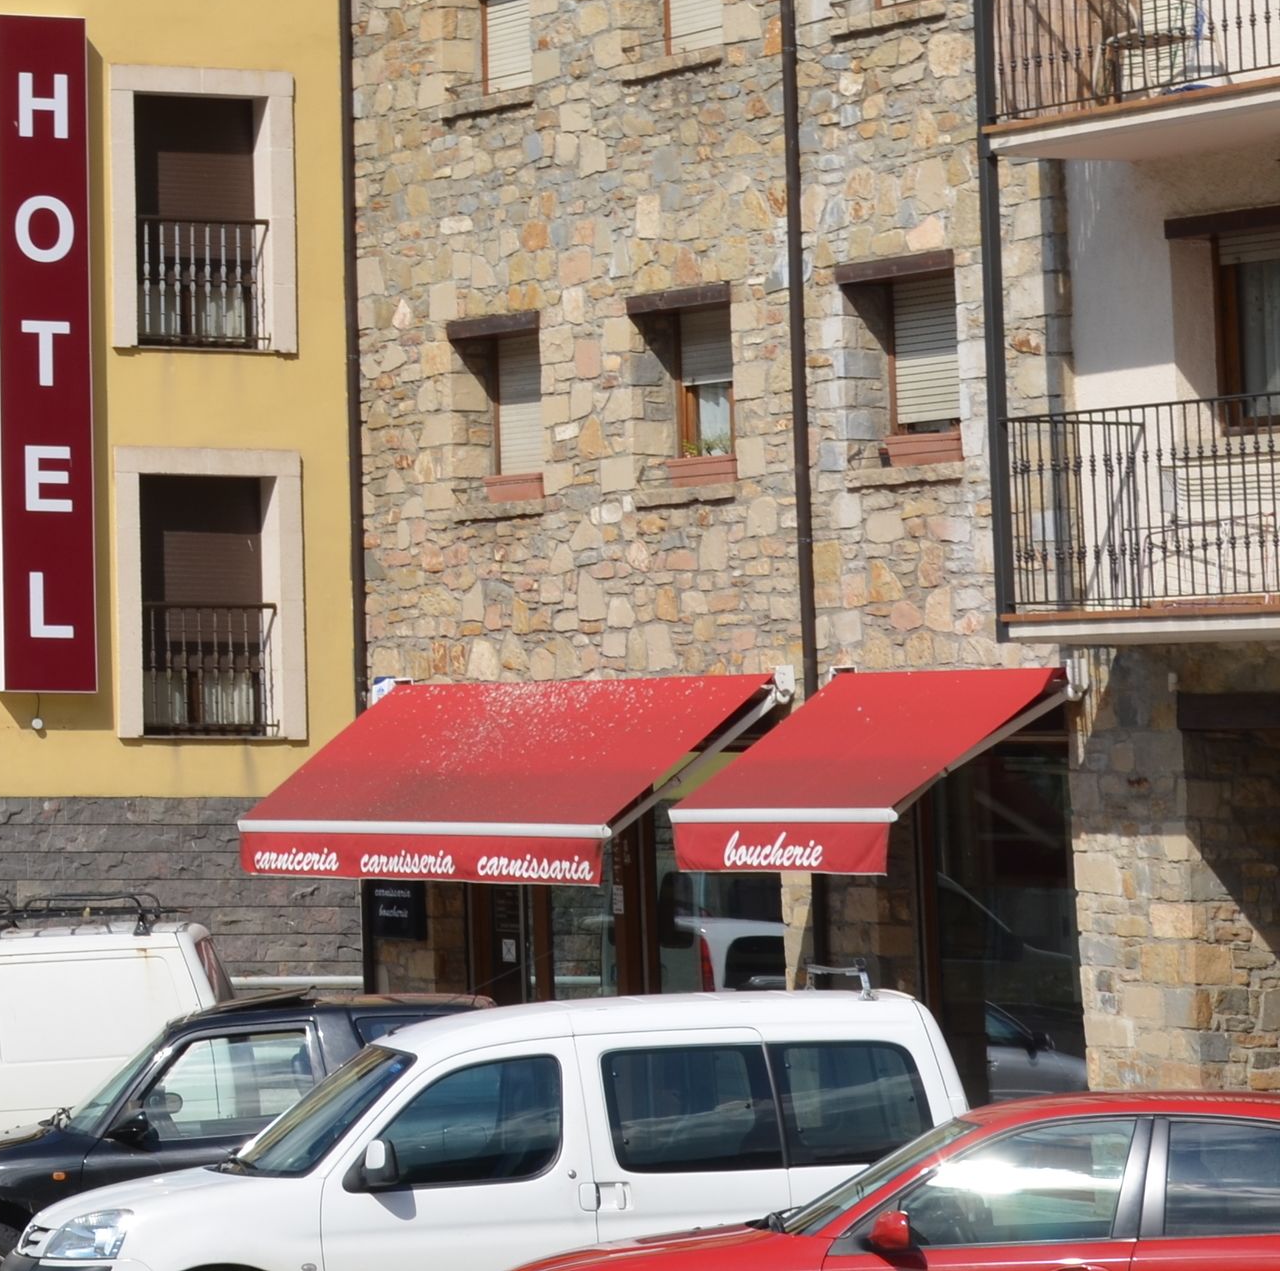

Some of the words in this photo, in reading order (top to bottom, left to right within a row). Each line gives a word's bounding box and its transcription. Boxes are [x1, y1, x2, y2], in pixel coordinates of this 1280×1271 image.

[15, 71, 75, 639] HOTEL
[254, 848, 340, 872] carniceria
[360, 849, 456, 875] carnisseria
[476, 854, 595, 881] carnissaria
[723, 830, 824, 867] boucherie
